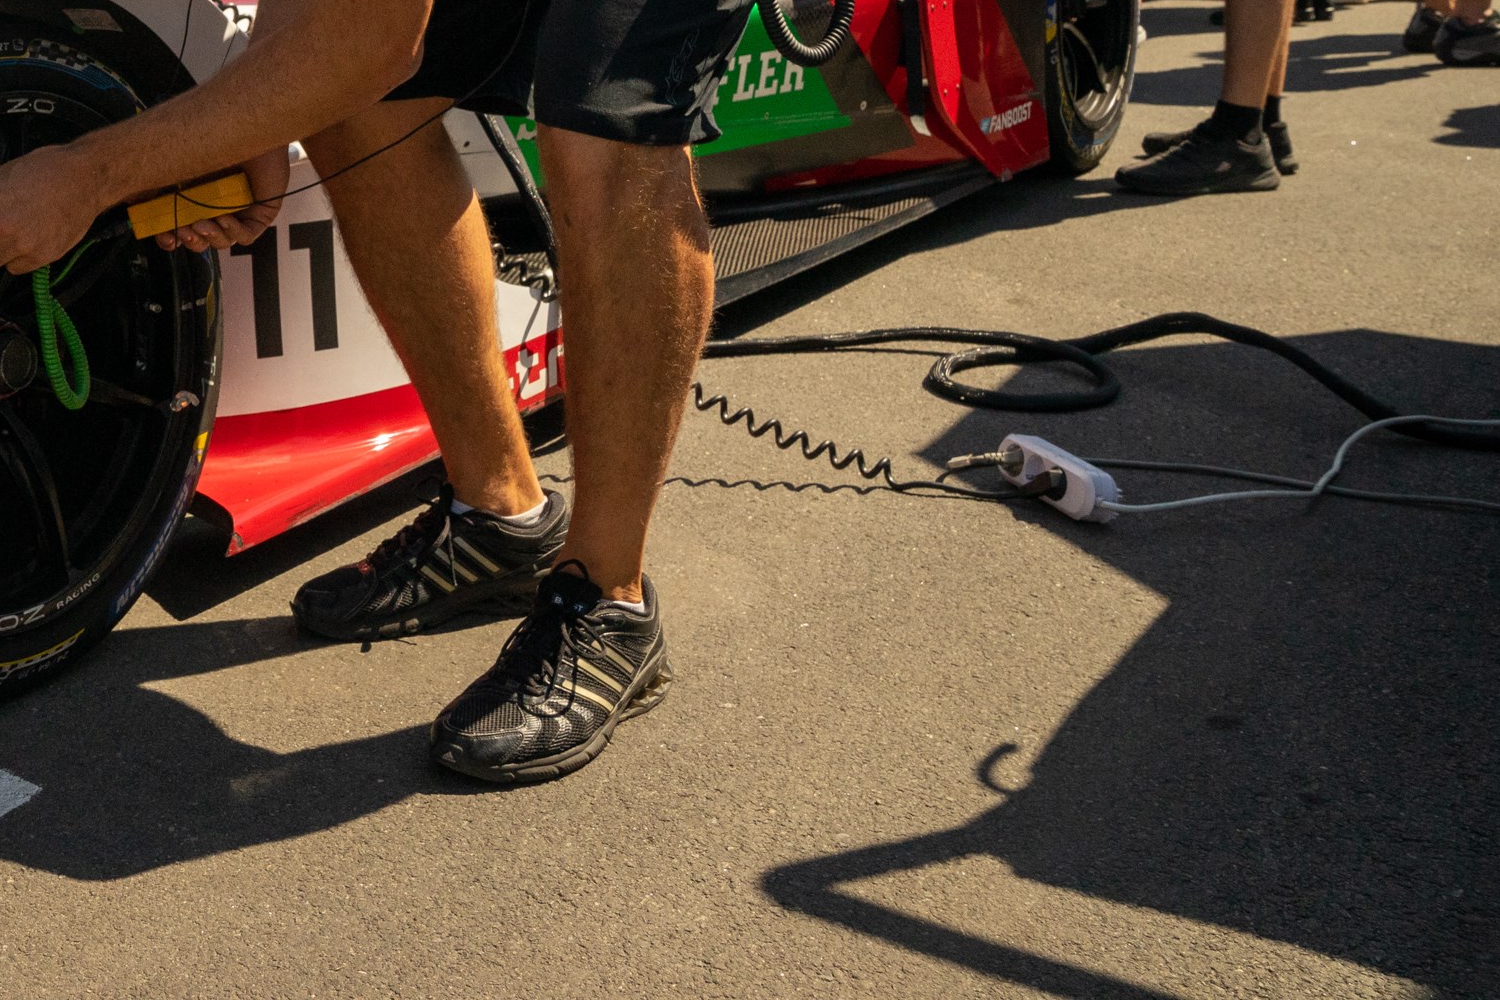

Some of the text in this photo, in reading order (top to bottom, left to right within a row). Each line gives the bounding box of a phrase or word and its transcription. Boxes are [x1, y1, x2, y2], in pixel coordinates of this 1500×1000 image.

[989, 101, 1033, 134] FANBOOST
[230, 219, 339, 359] 11
[56, 572, 101, 610] RACING
